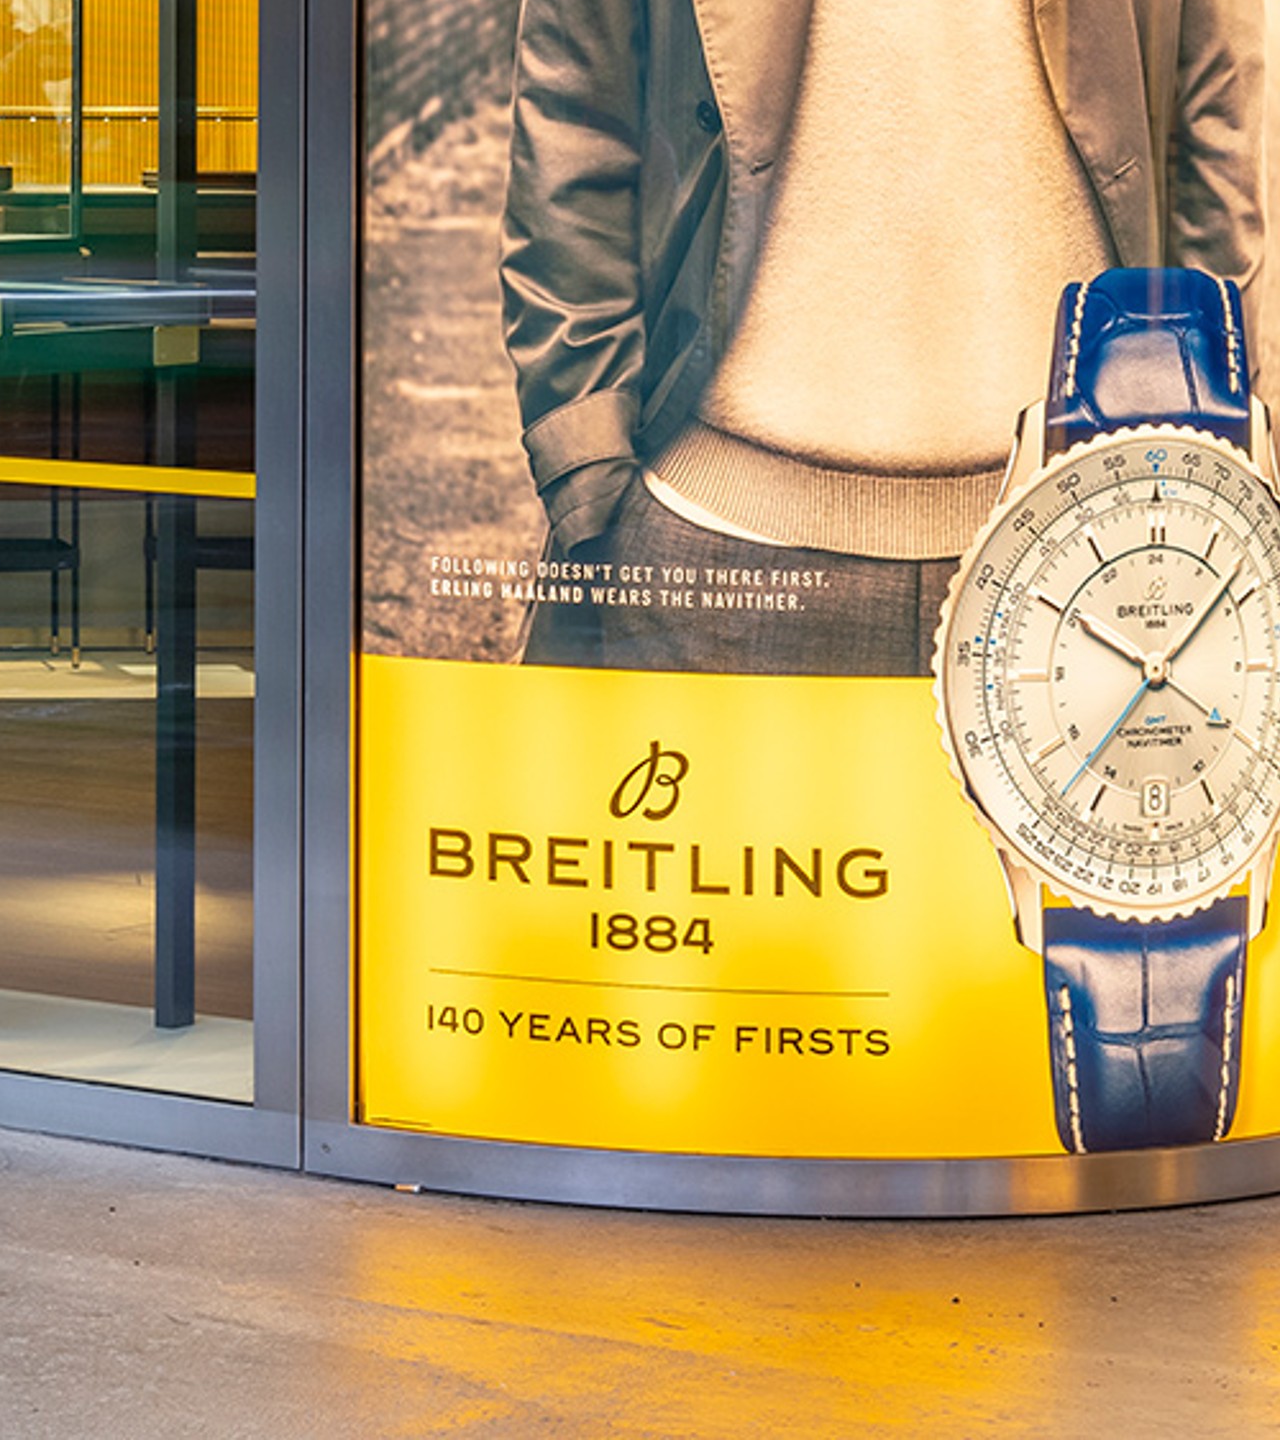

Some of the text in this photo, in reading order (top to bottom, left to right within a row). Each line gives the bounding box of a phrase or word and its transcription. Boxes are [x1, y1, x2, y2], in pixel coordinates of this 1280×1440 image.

[1145, 448, 1168, 462] 60
[1013, 508, 1035, 532] 45
[431, 557, 830, 588] FOLLOWING DOESN'T GET YOU THERE FIRST.
[431, 579, 805, 611] ERLING HAALAND WEARS THE NAVITIMER.
[1117, 603, 1194, 618] BREITLING
[429, 827, 889, 899] BREITLING
[591, 912, 714, 955] 1884
[428, 1004, 890, 1056] 140 YEARS OF FIRSTS
